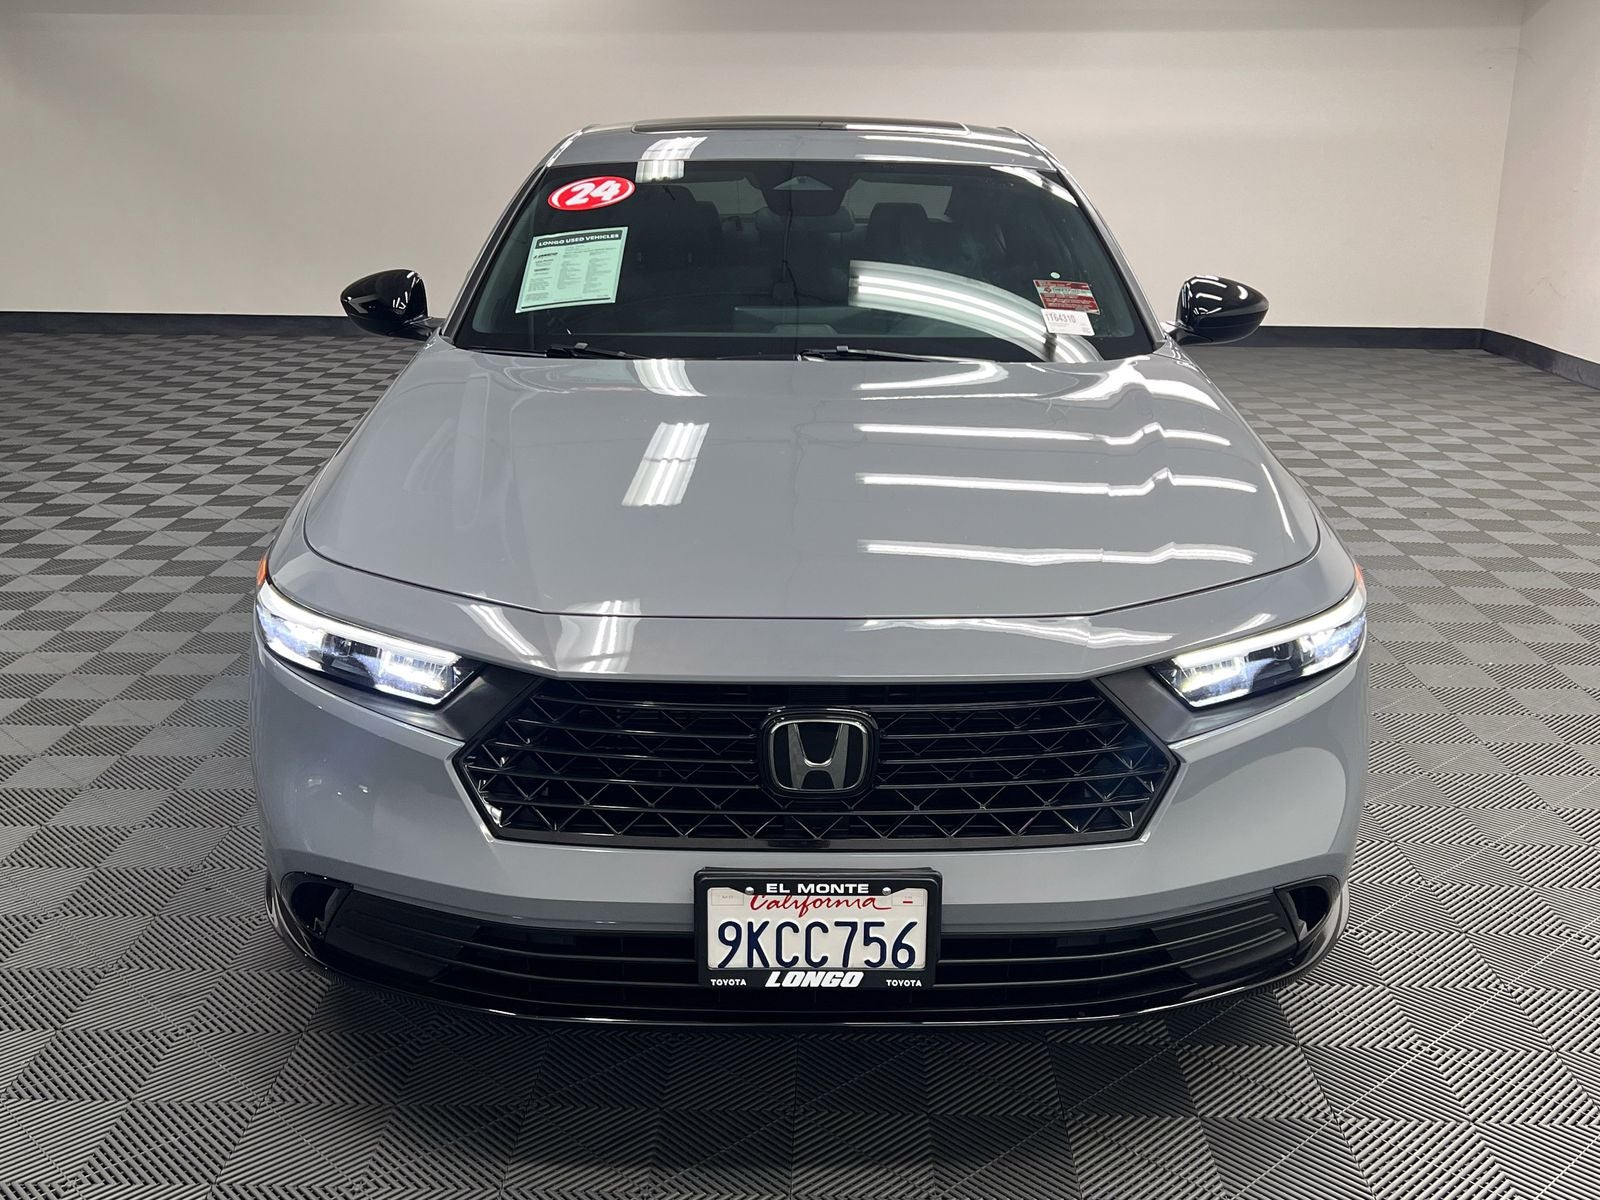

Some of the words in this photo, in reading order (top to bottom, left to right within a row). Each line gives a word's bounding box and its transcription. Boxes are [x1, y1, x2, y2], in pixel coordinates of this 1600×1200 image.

[565, 180, 622, 206] 24
[565, 236, 585, 244] USED
[585, 233, 619, 241] VEHICLES
[765, 883, 790, 894] EL
[797, 883, 870, 894] MONTE
[750, 894, 892, 918] California
[717, 920, 918, 969] 9KCC756
[710, 978, 747, 987] TOYOTA
[764, 971, 865, 988] LONGO
[885, 979, 922, 987] TOYOTA
